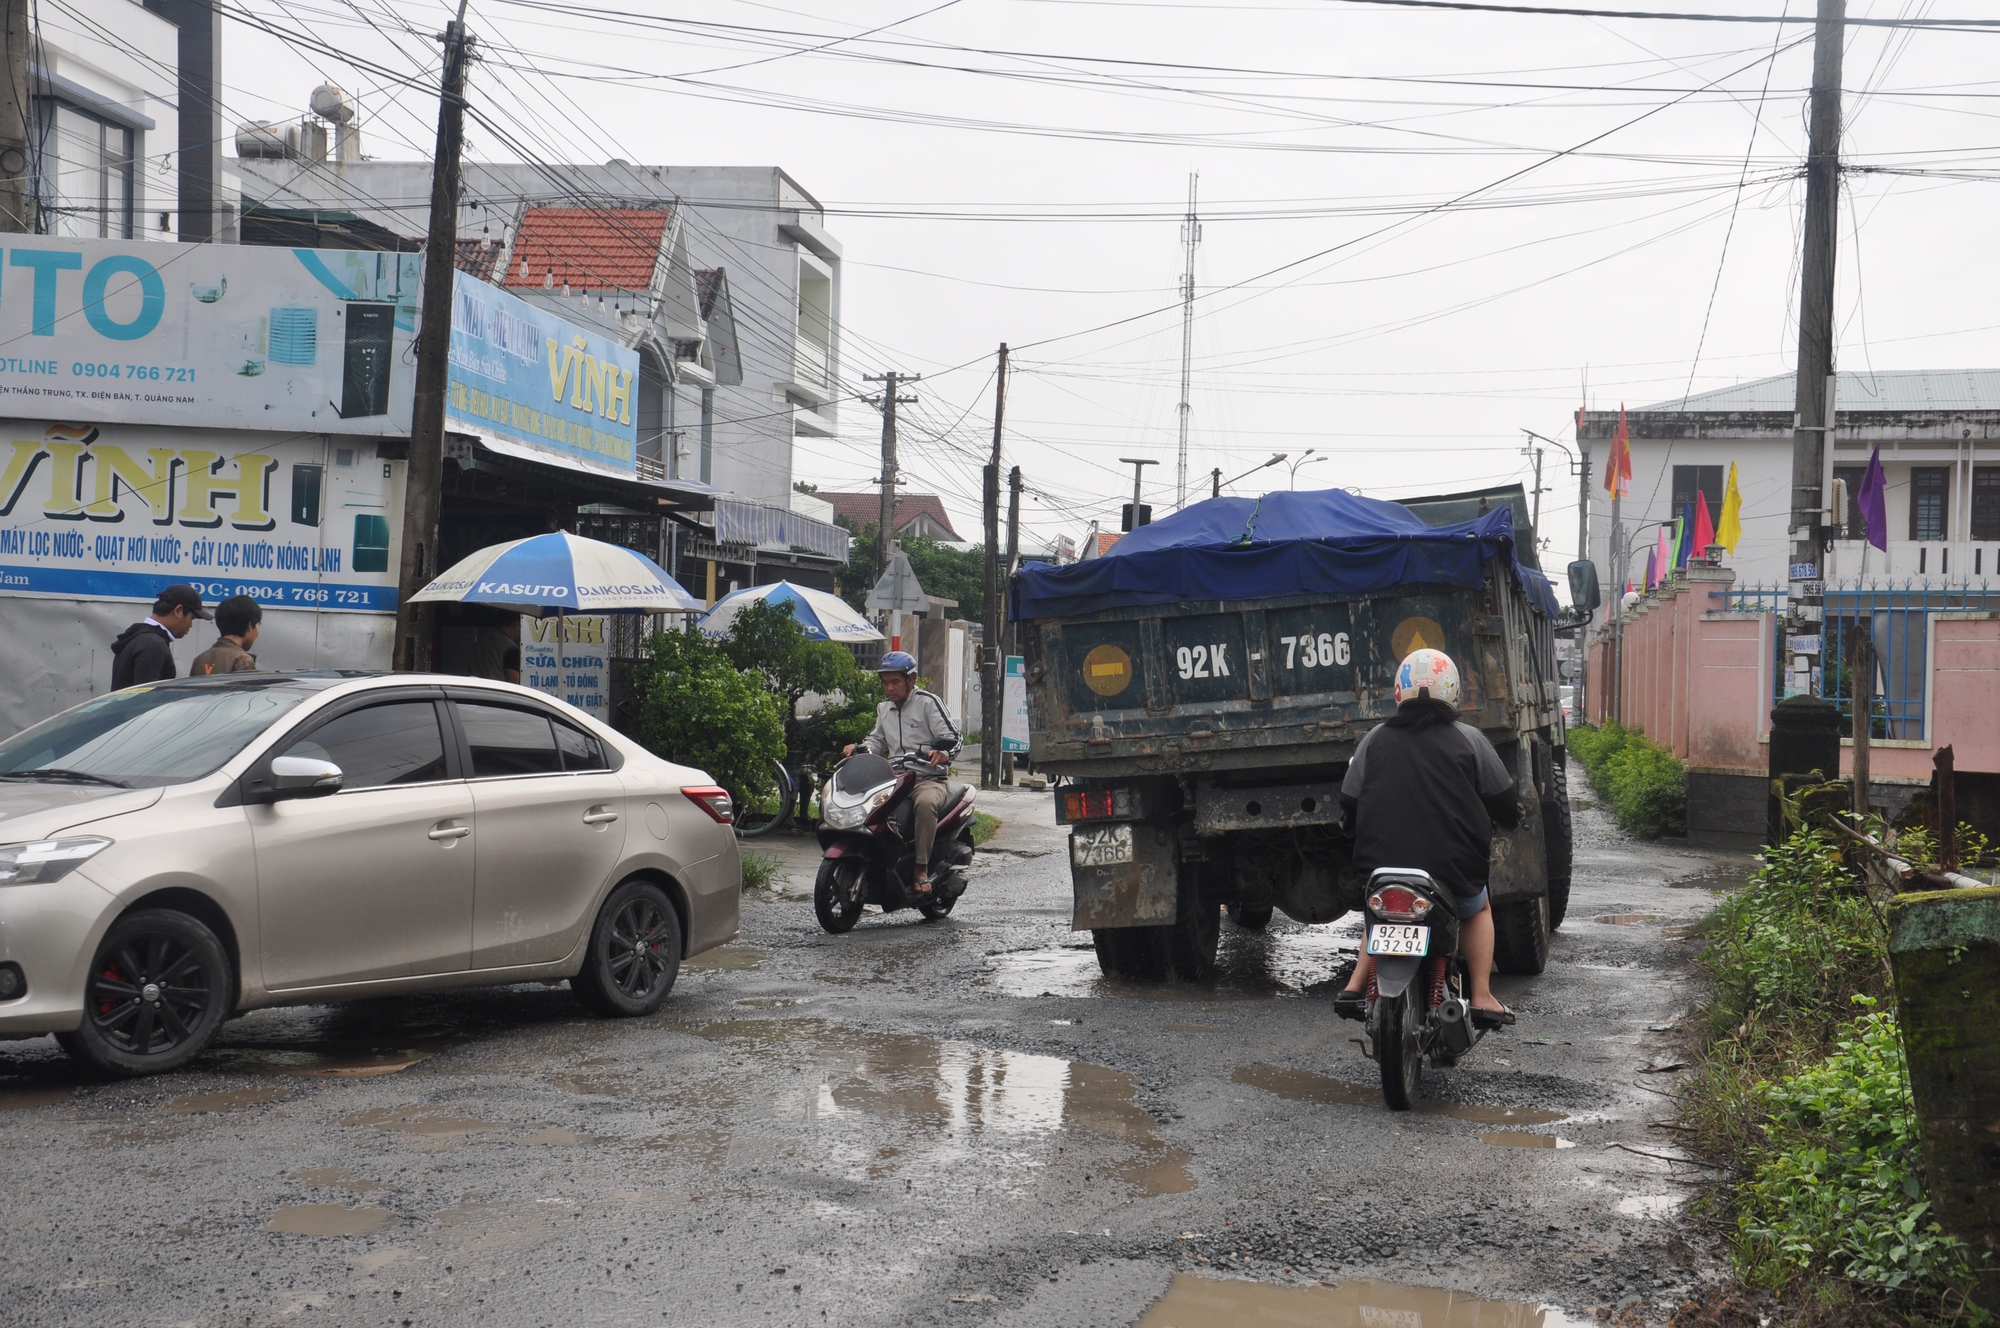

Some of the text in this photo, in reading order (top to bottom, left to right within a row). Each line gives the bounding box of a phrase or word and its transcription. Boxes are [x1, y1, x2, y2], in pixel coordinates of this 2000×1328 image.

[0, 248, 165, 341] TO
[72, 362, 120, 378] 0904
[126, 365, 160, 380] 766
[165, 367, 196, 382] 721
[546, 335, 631, 425] VĨNH
[42, 389, 73, 398] TRUNG,
[76, 390, 89, 398] TX.
[91, 390, 111, 400] ĐIỆN
[135, 393, 142, 401] T.
[176, 396, 195, 404] NAM
[1, 525, 26, 555] MÁY
[29, 531, 50, 561] LỌC
[53, 529, 84, 559] NƯỚC
[95, 535, 125, 566] QUẠT
[127, 535, 147, 562] HƠI
[150, 534, 181, 564] NƯỚC
[192, 536, 215, 566] CÂY
[217, 542, 239, 572] LỌC
[242, 539, 274, 569] NƯỚC
[277, 541, 308, 571] NÓNG
[311, 547, 341, 577] LẠNH
[189, 582, 371, 604] ĐC: 0904 766 721
[478, 582, 568, 598] KASUTO
[577, 584, 666, 596] DAIKIOSAN
[525, 653, 603, 668] SỬA CHỮA
[1177, 643, 1230, 680] 92K
[1281, 632, 1350, 669] 7366
[530, 671, 539, 687] TỦ
[577, 673, 598, 688] ĐÔNG
[567, 692, 584, 706] MÁY
[586, 692, 603, 709] GIẶT
[1379, 926, 1419, 939] 92-CA
[1371, 940, 1422, 953] 032.94
